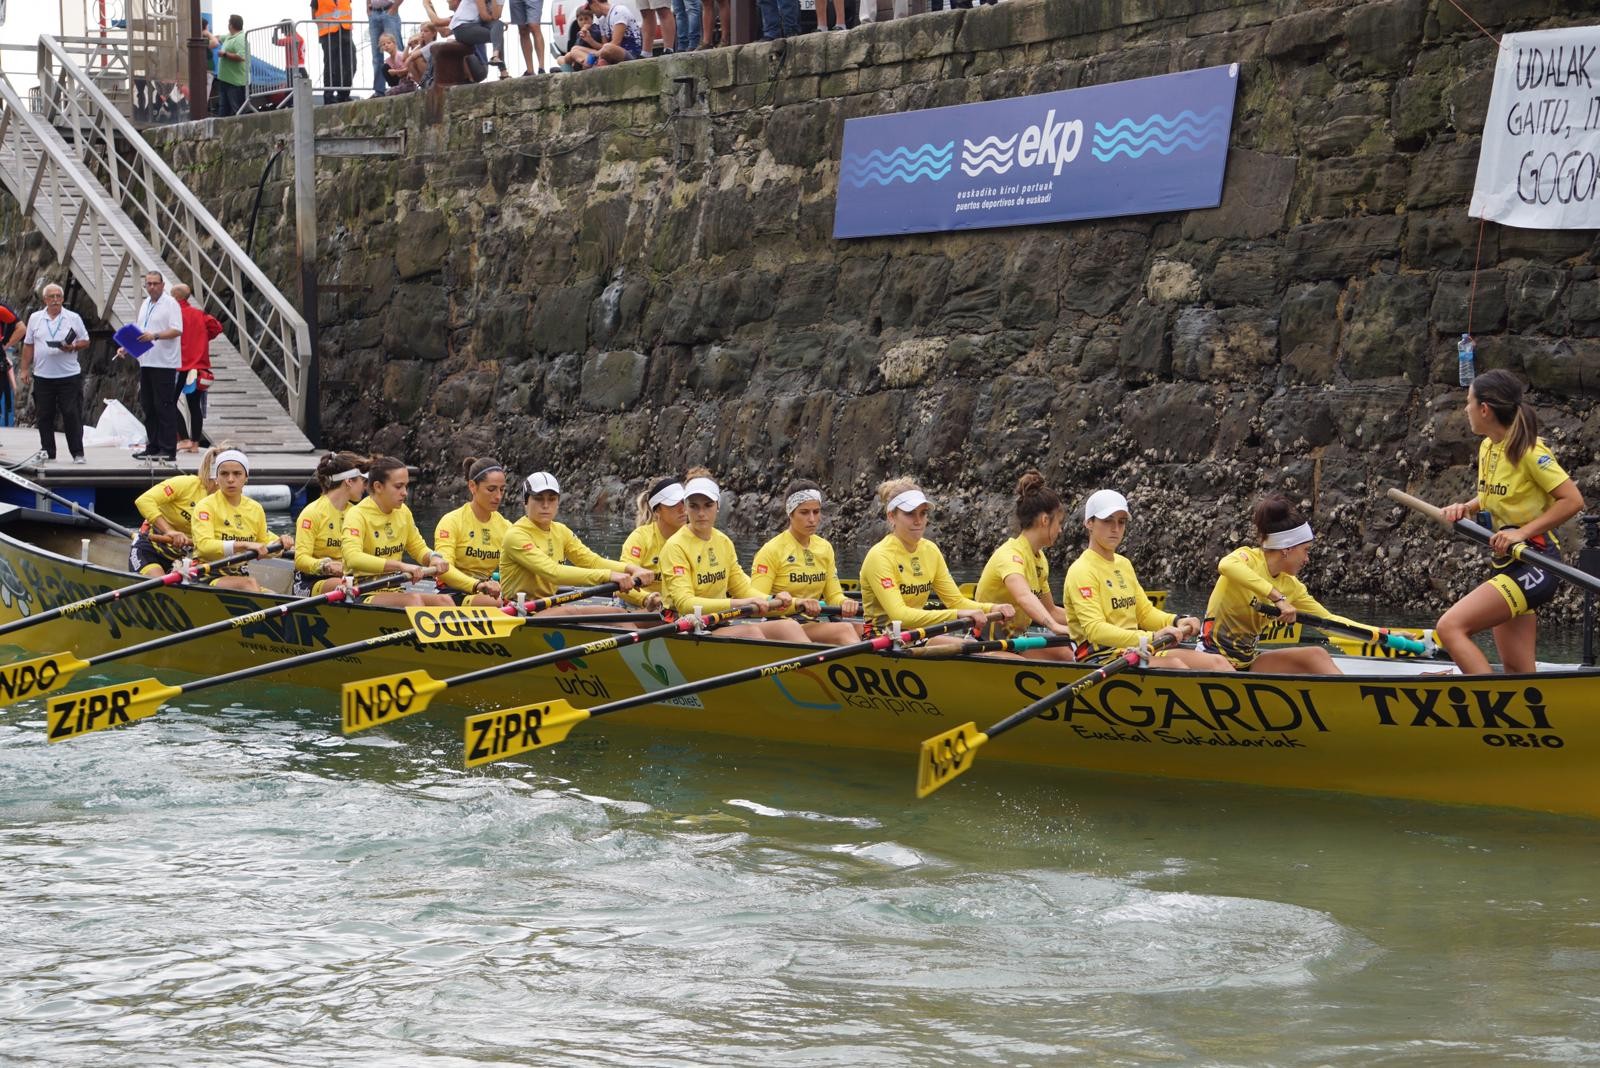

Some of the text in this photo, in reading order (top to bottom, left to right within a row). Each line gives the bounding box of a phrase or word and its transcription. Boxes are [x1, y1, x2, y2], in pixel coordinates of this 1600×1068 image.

[1516, 44, 1596, 91] UDALAK
[1018, 109, 1083, 175] ekp
[955, 193, 1052, 213] puertos deportivos de euskadi
[957, 180, 1053, 200] euskadiko kirol portuak
[554, 674, 610, 699] urbil
[828, 663, 928, 700] ORIO
[347, 677, 416, 728] INDO
[840, 692, 944, 717] kanpina
[1014, 670, 1330, 732] SAGARDI
[1070, 724, 1306, 749] Euskal Sukaldariak
